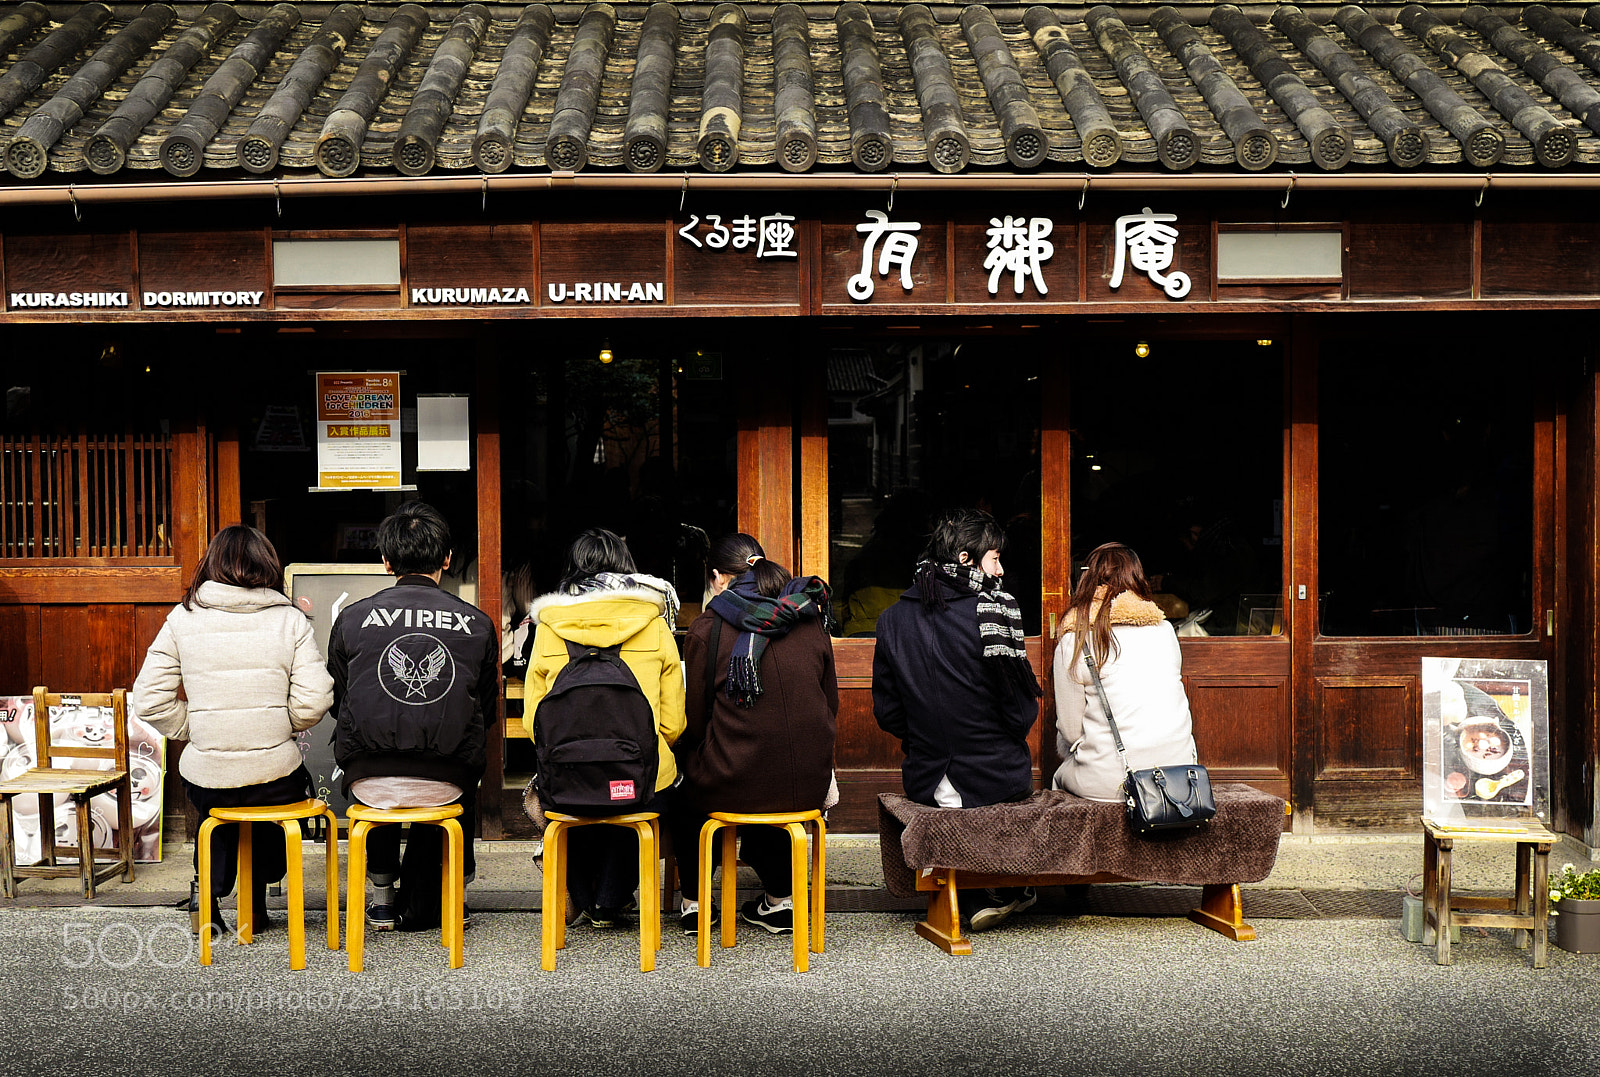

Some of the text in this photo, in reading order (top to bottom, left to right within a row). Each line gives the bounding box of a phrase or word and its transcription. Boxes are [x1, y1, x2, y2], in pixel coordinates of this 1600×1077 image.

[678, 213, 798, 257] くるま座
[11, 291, 264, 307] KURASHIKI DORMITORY
[411, 287, 530, 303] KURUMAZA
[548, 282, 664, 302] U-RIN-AN
[325, 394, 350, 402] LOVE
[357, 394, 393, 402] DREAM
[326, 402, 340, 410] for
[329, 426, 389, 436] 入賞作品展示
[360, 608, 472, 635] AVIREX
